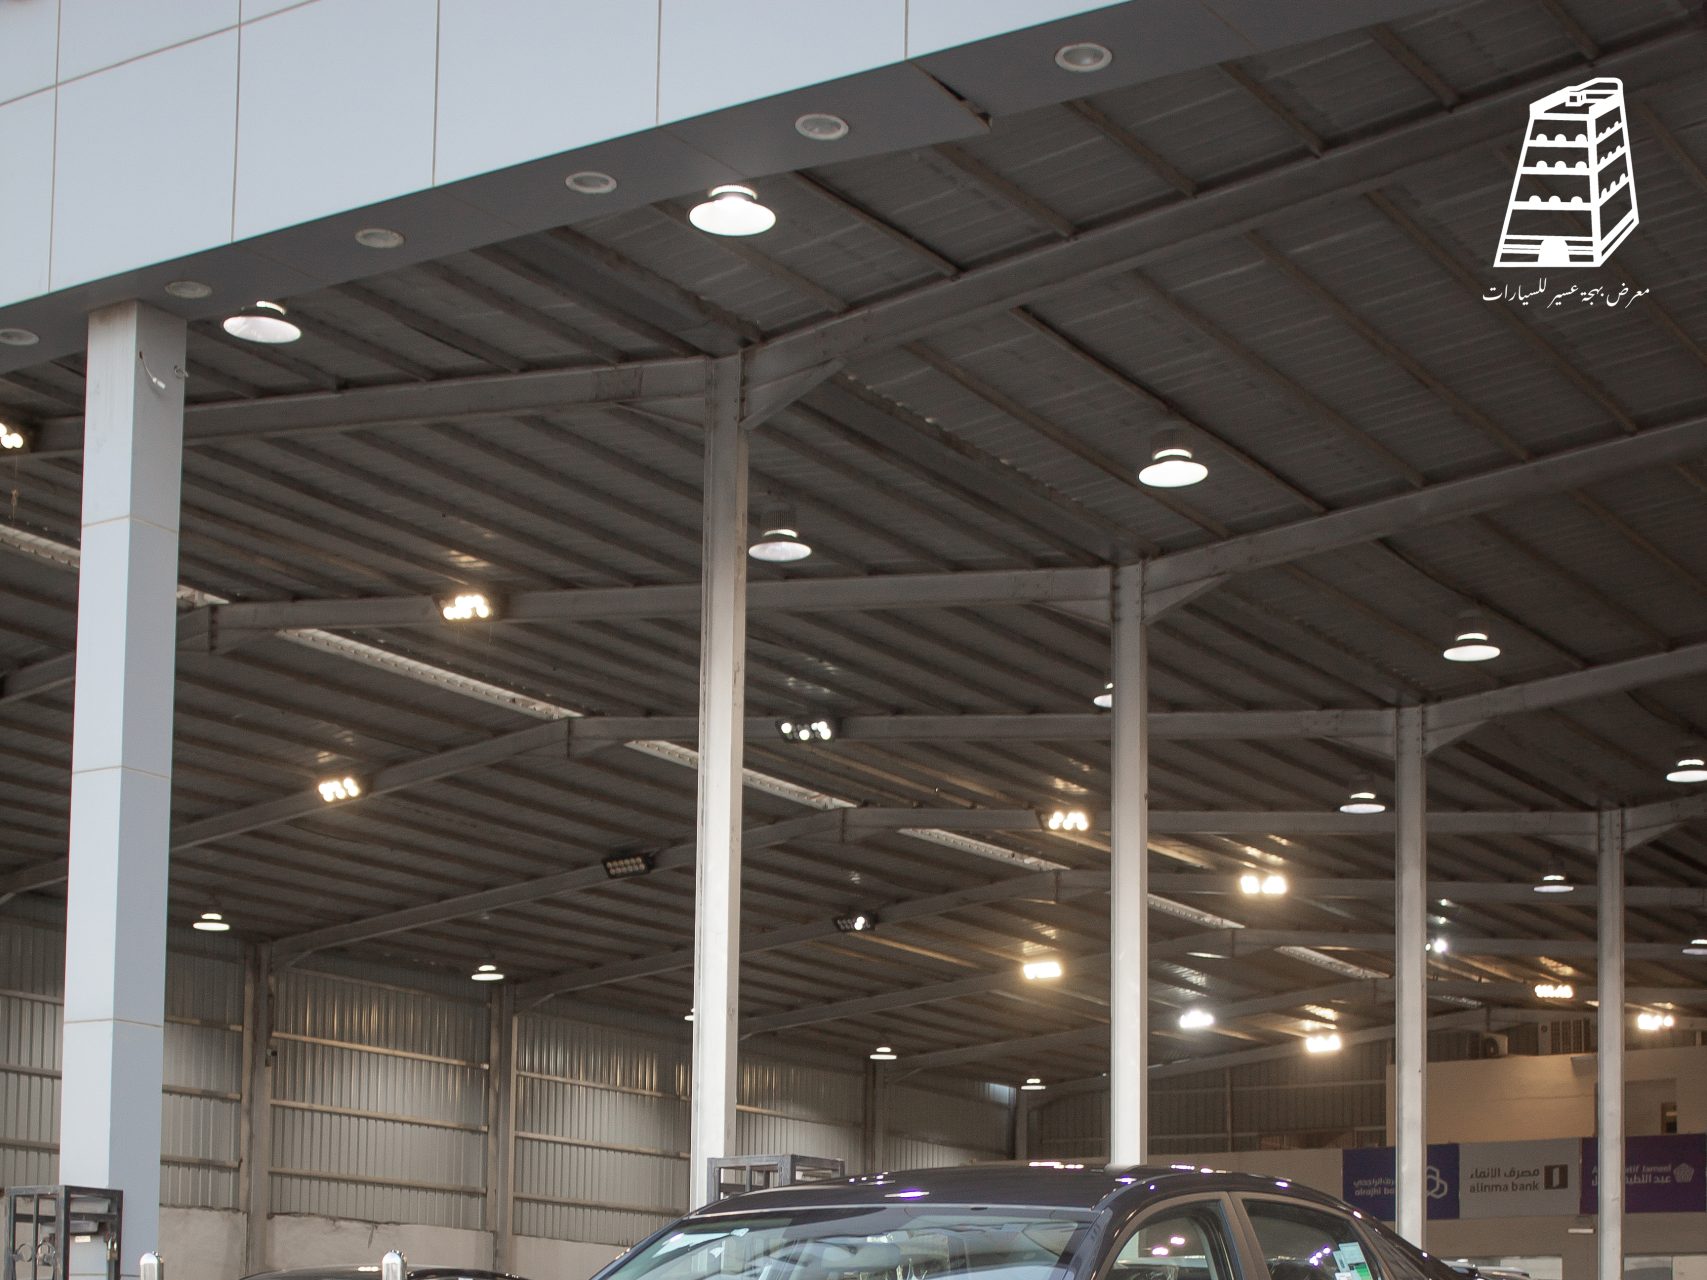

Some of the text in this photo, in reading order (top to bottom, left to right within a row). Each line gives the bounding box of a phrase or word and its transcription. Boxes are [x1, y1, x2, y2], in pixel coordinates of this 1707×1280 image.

[1503, 1167, 1540, 1180] مصرف
[1469, 1181, 1539, 1193] alinma bank
